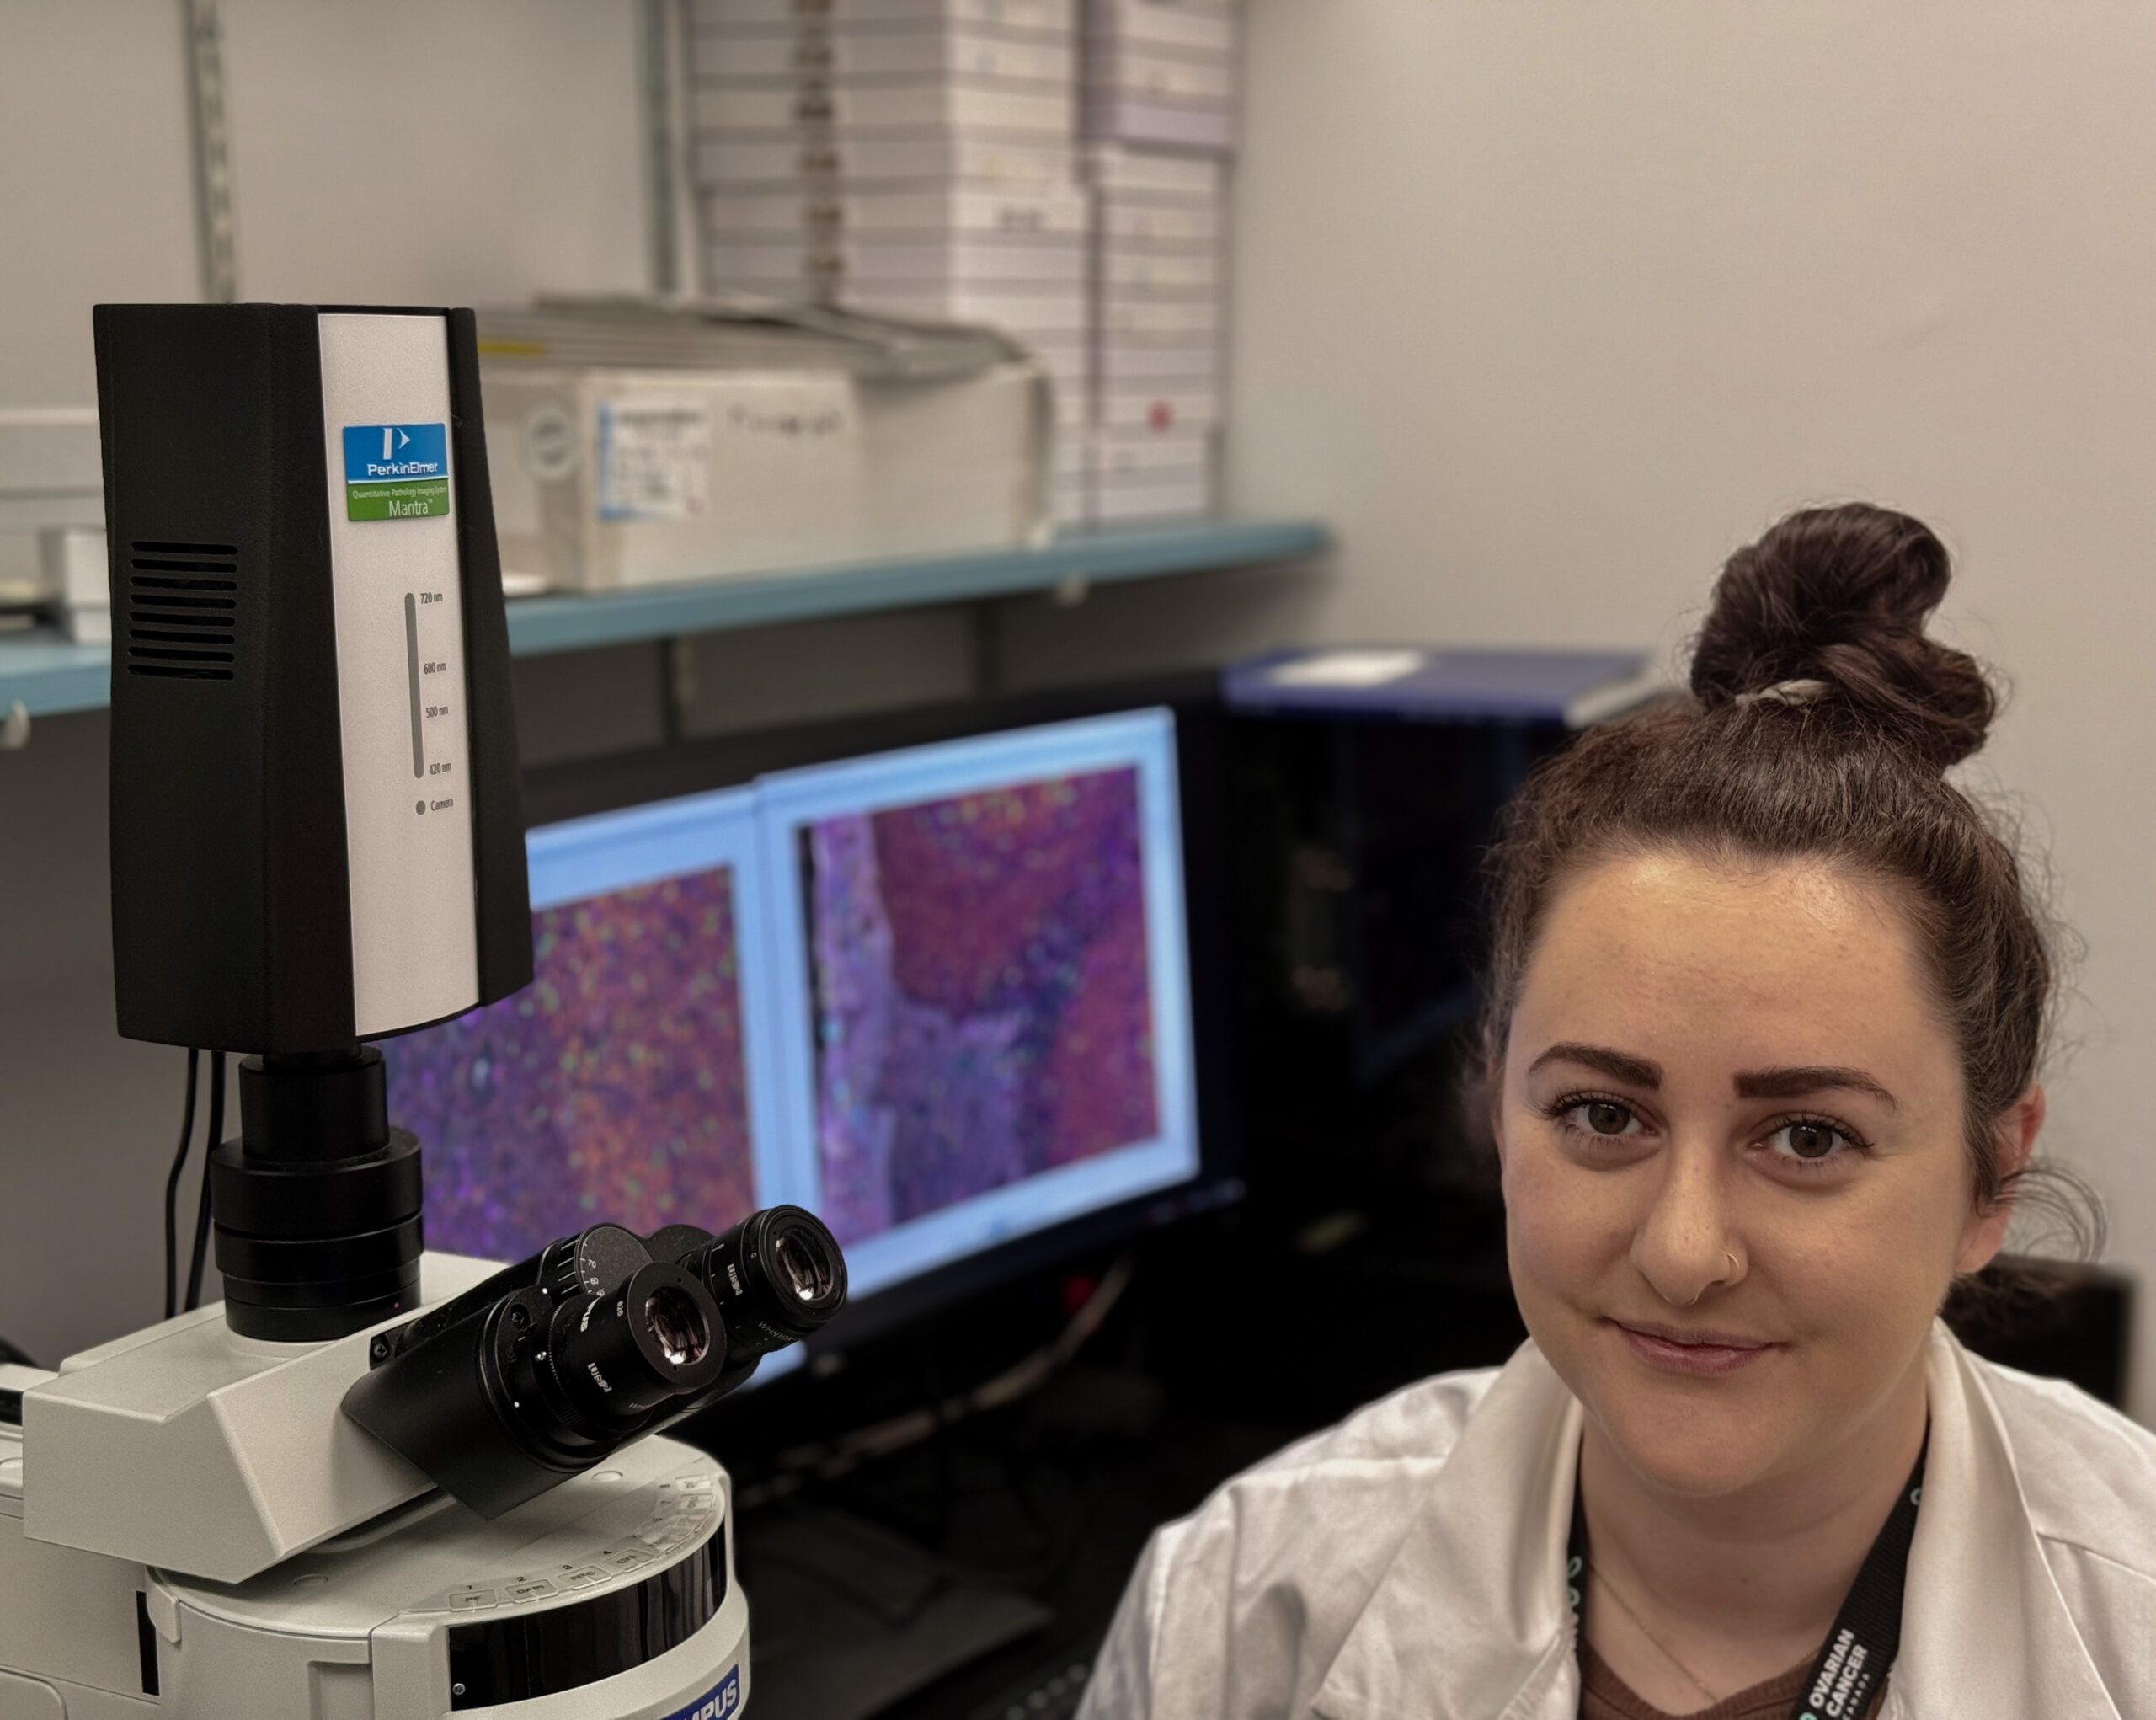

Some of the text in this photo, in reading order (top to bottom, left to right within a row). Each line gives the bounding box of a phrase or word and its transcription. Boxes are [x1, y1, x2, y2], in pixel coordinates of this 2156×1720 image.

[367, 462, 438, 477] PerkinElmer
[352, 490, 391, 499] Quantitative
[391, 488, 417, 497] Pathology
[417, 488, 435, 496] Imaging
[420, 592, 443, 605] 720 nm
[424, 662, 446, 675] 600 nm
[425, 706, 448, 718] 500 nm
[429, 762, 451, 775] 420 nm
[430, 799, 453, 811] Camera
[1808, 1628, 1855, 1709] OVARIAN
[1825, 1644, 1869, 1717] CANCER
